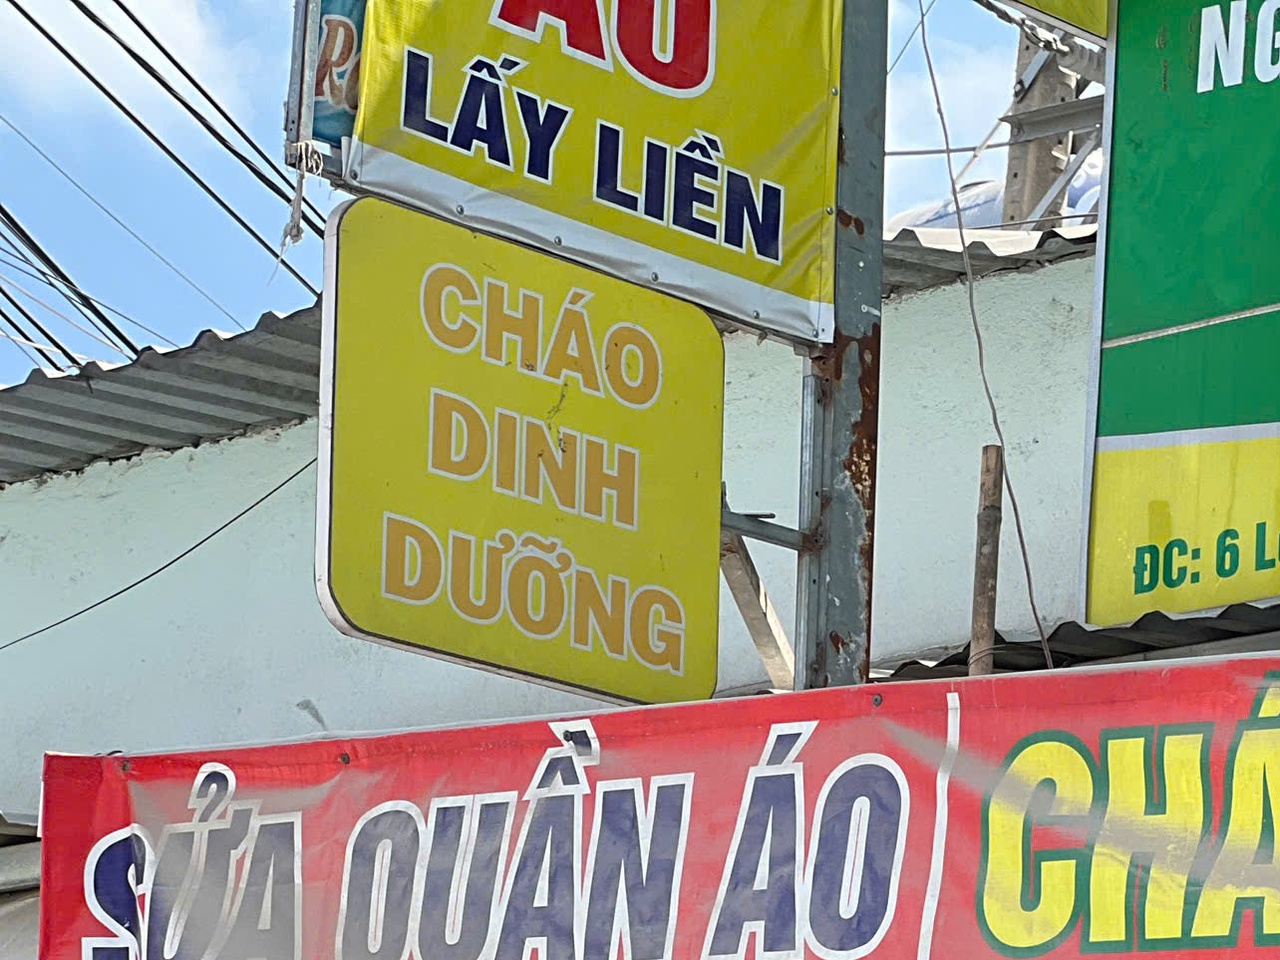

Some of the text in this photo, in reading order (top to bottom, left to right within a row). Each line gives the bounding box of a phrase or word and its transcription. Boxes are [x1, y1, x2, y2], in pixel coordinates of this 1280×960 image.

[401, 48, 572, 185] LẤY
[592, 118, 784, 265] LIỀN
[418, 262, 662, 409] CHÁO
[427, 387, 639, 531] DINH
[381, 511, 685, 677] DƯỠNG
[1133, 538, 1201, 595] ĐC:
[1215, 529, 1240, 578] 6
